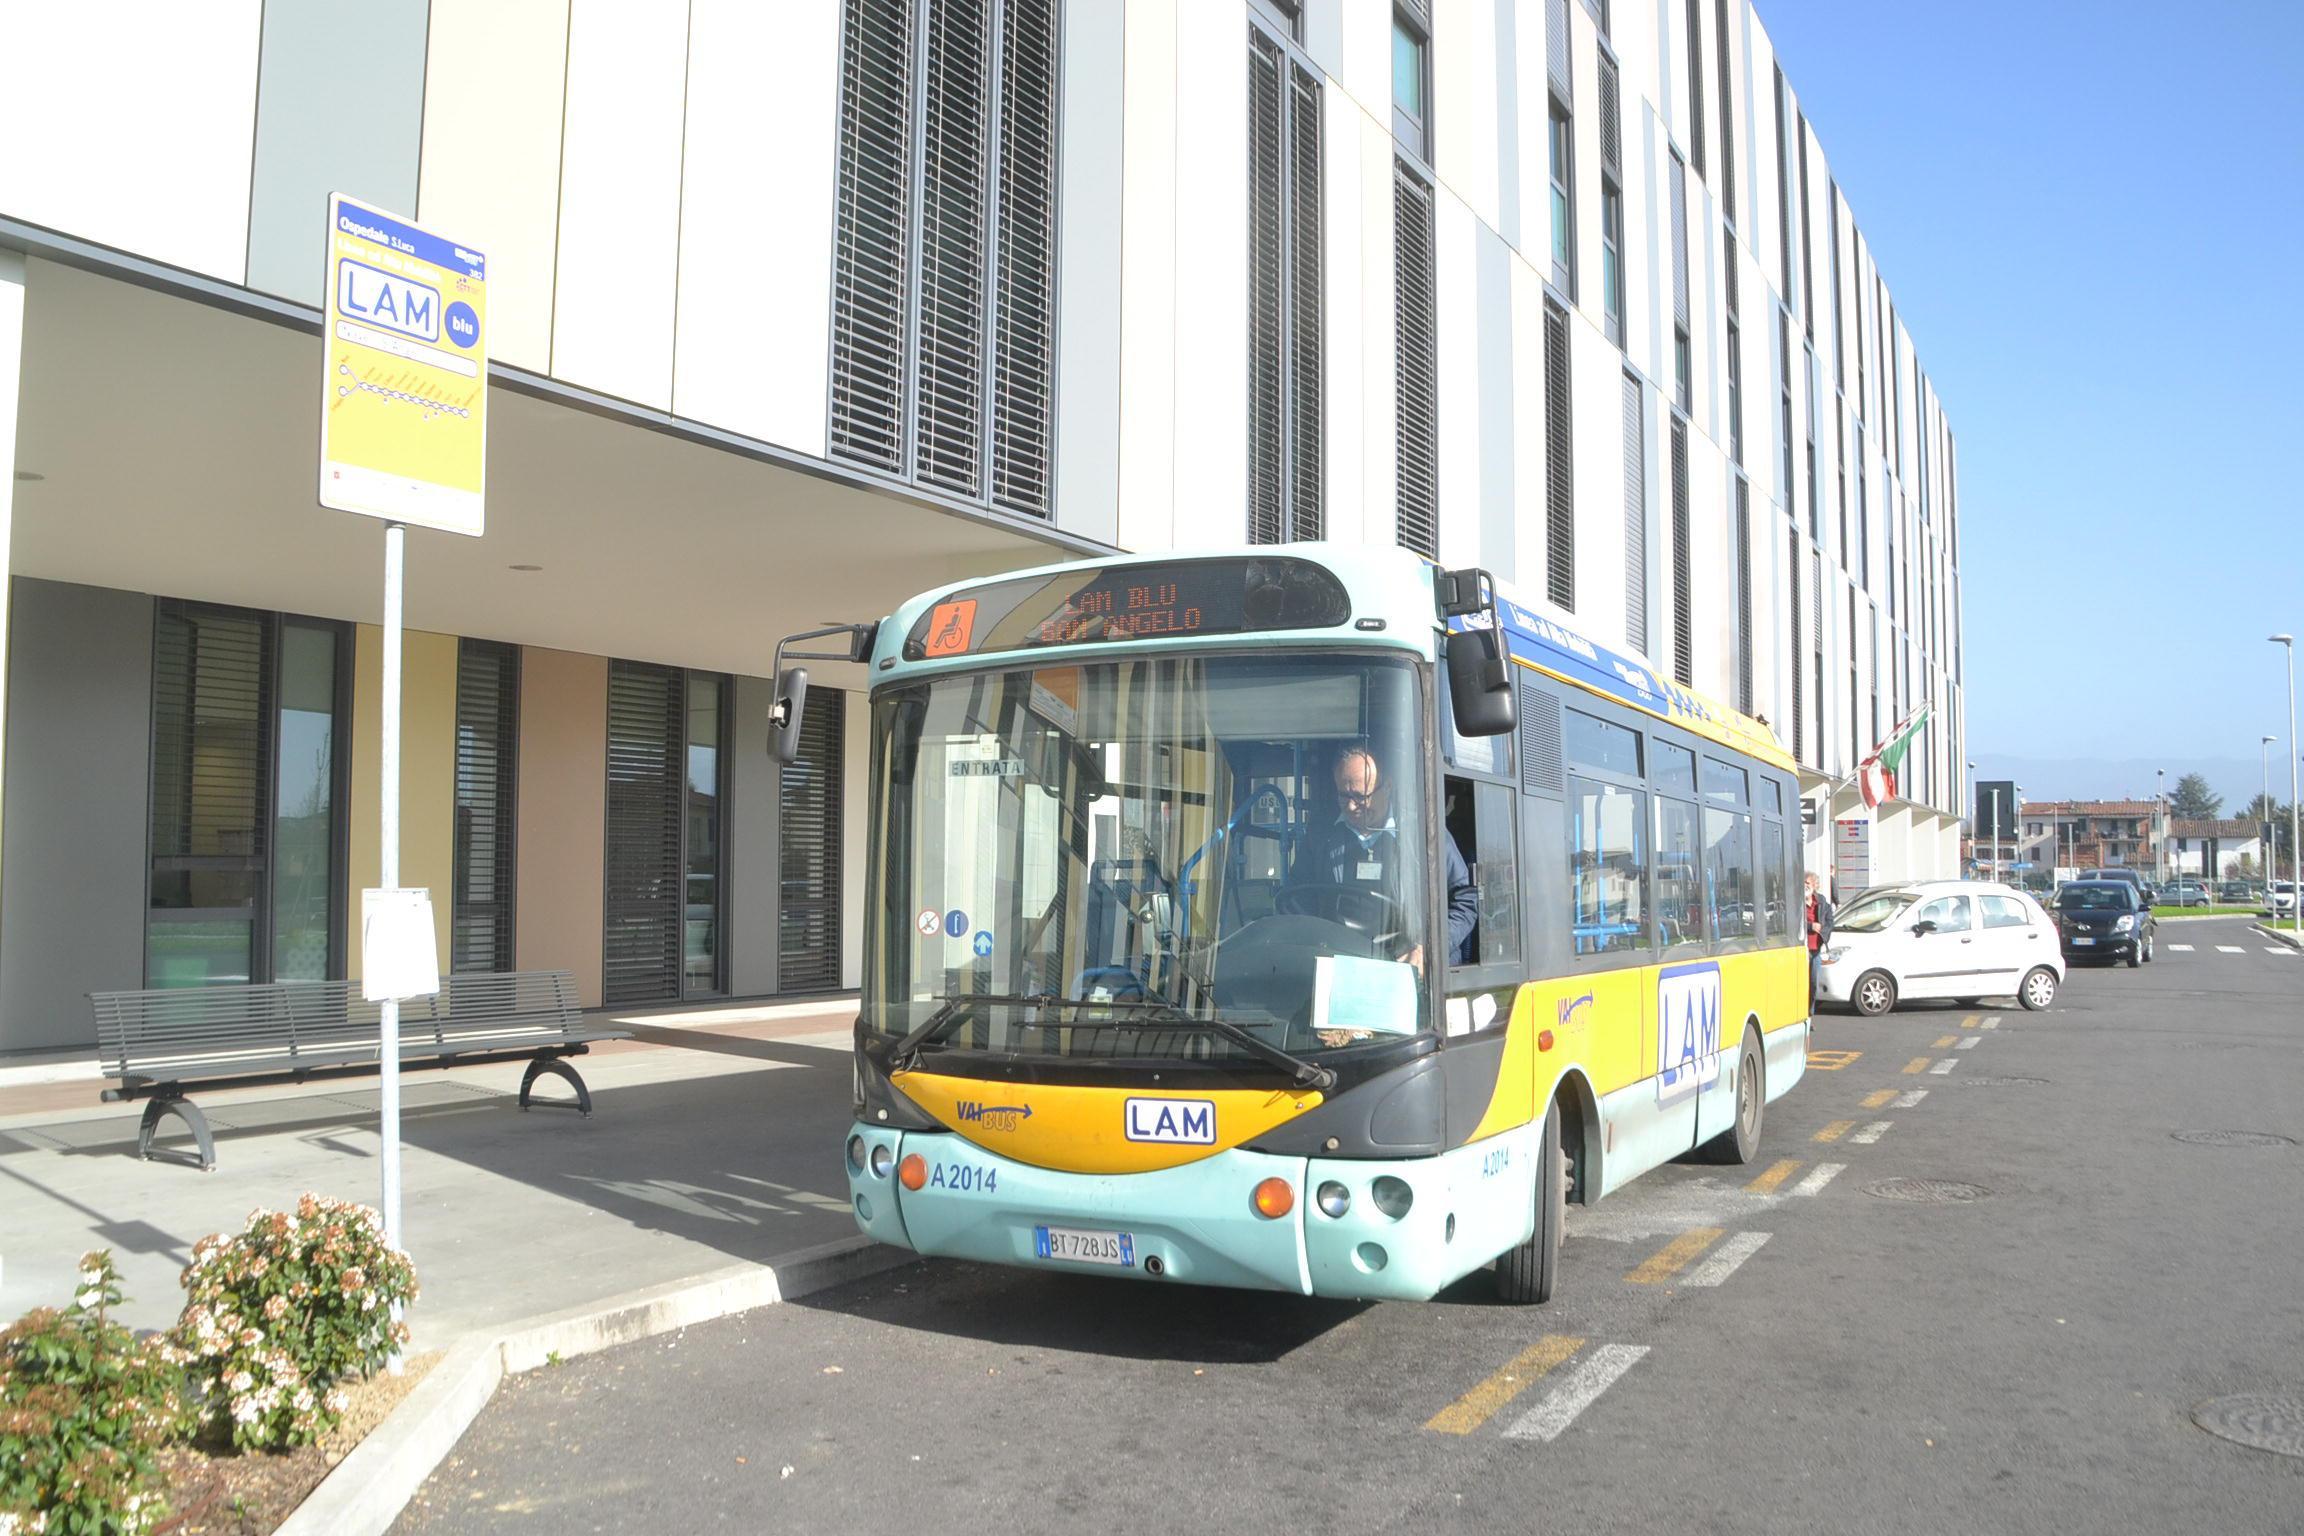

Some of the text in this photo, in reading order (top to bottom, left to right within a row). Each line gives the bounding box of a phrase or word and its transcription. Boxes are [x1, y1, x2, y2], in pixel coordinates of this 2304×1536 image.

[340, 216, 389, 245] Ospedale
[349, 270, 430, 332] LAM
[452, 316, 473, 335] blu
[1064, 584, 1177, 615] LAM BLU
[1103, 608, 1200, 637] ANGELO
[952, 761, 1020, 776] ENTRATA
[1665, 984, 1717, 1087] LAM
[956, 1101, 1016, 1132] VAI BUS
[1132, 1104, 1208, 1138] LAM
[1050, 1233, 1067, 1255] BT
[1071, 1235, 1119, 1259] 728JS
